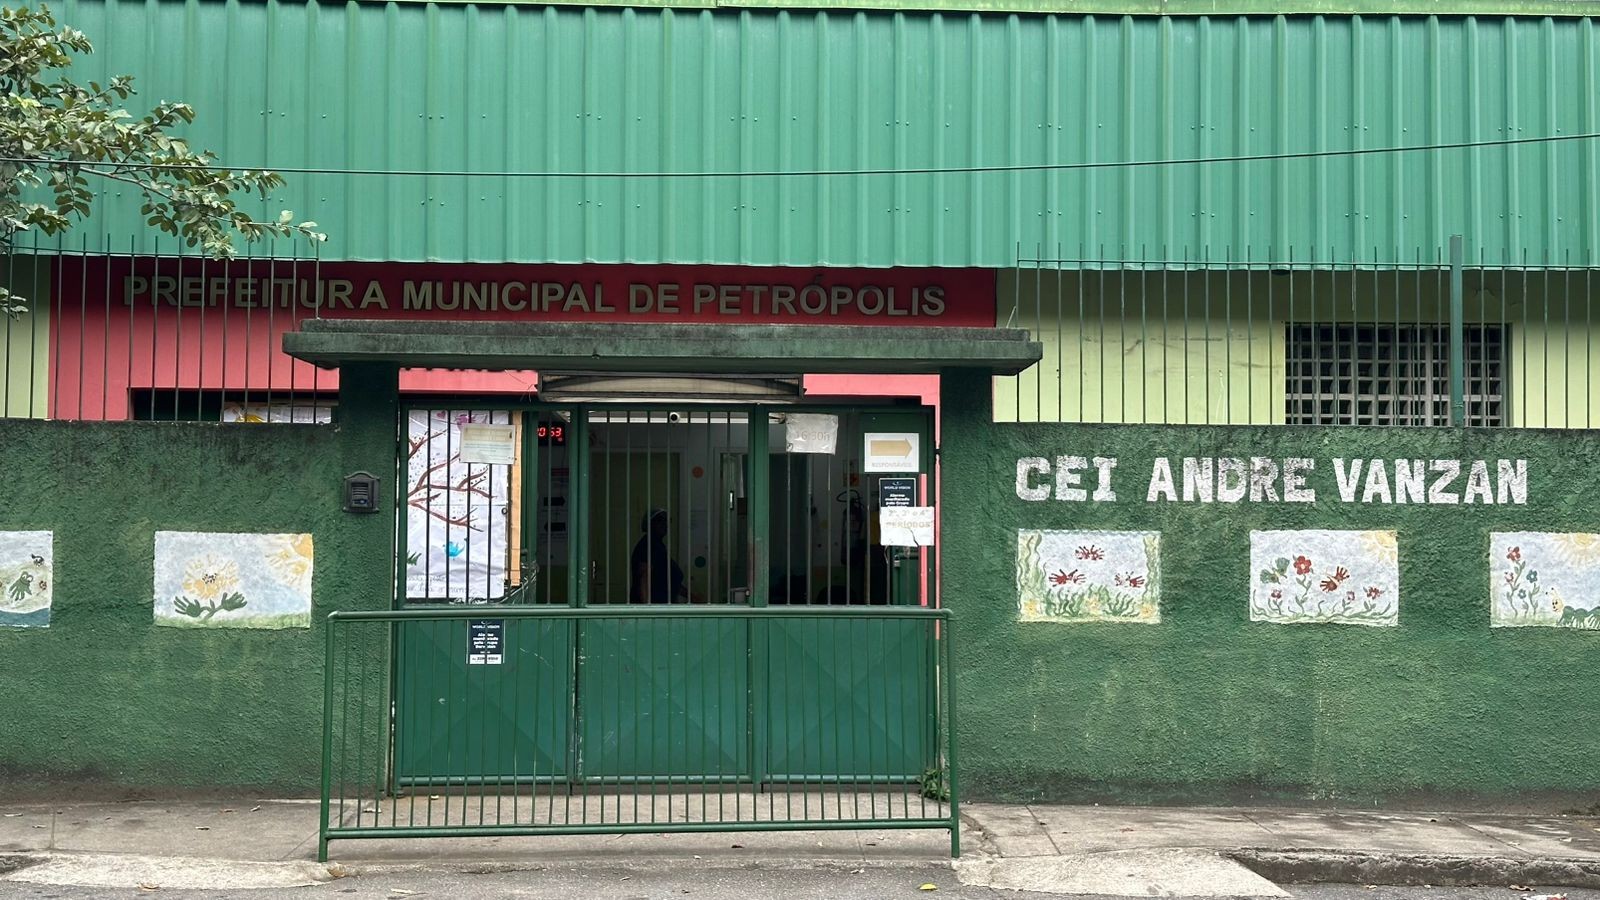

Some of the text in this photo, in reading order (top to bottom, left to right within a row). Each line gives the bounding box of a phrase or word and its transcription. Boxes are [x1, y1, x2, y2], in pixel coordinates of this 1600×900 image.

[123, 274, 945, 316] PREFEITURA MUNICIPAL DE PETRÓPOLIS
[1015, 455, 1528, 505] CEI ANDRE VANZAN
